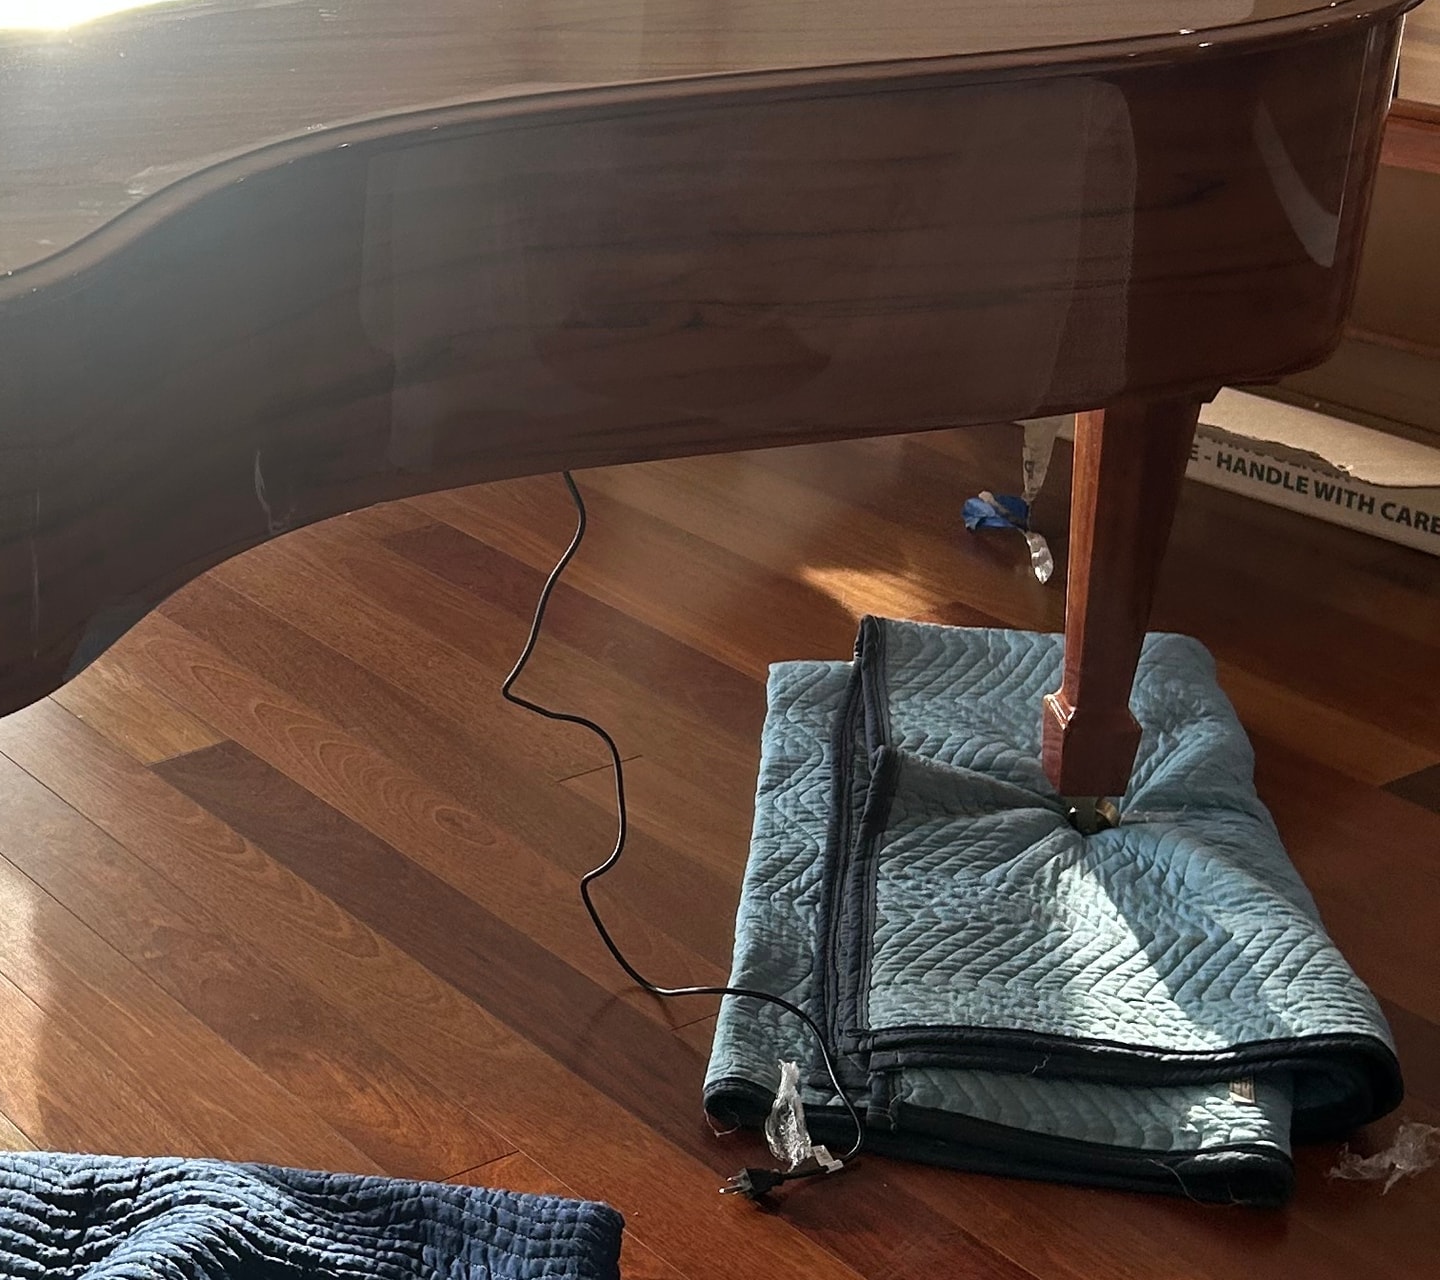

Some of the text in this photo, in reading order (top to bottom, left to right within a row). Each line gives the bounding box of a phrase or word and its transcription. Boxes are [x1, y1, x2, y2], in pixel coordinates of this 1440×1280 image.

[1216, 451, 1309, 495] HANDLE
[1314, 480, 1376, 515] WITH
[1380, 501, 1440, 535] CARE
